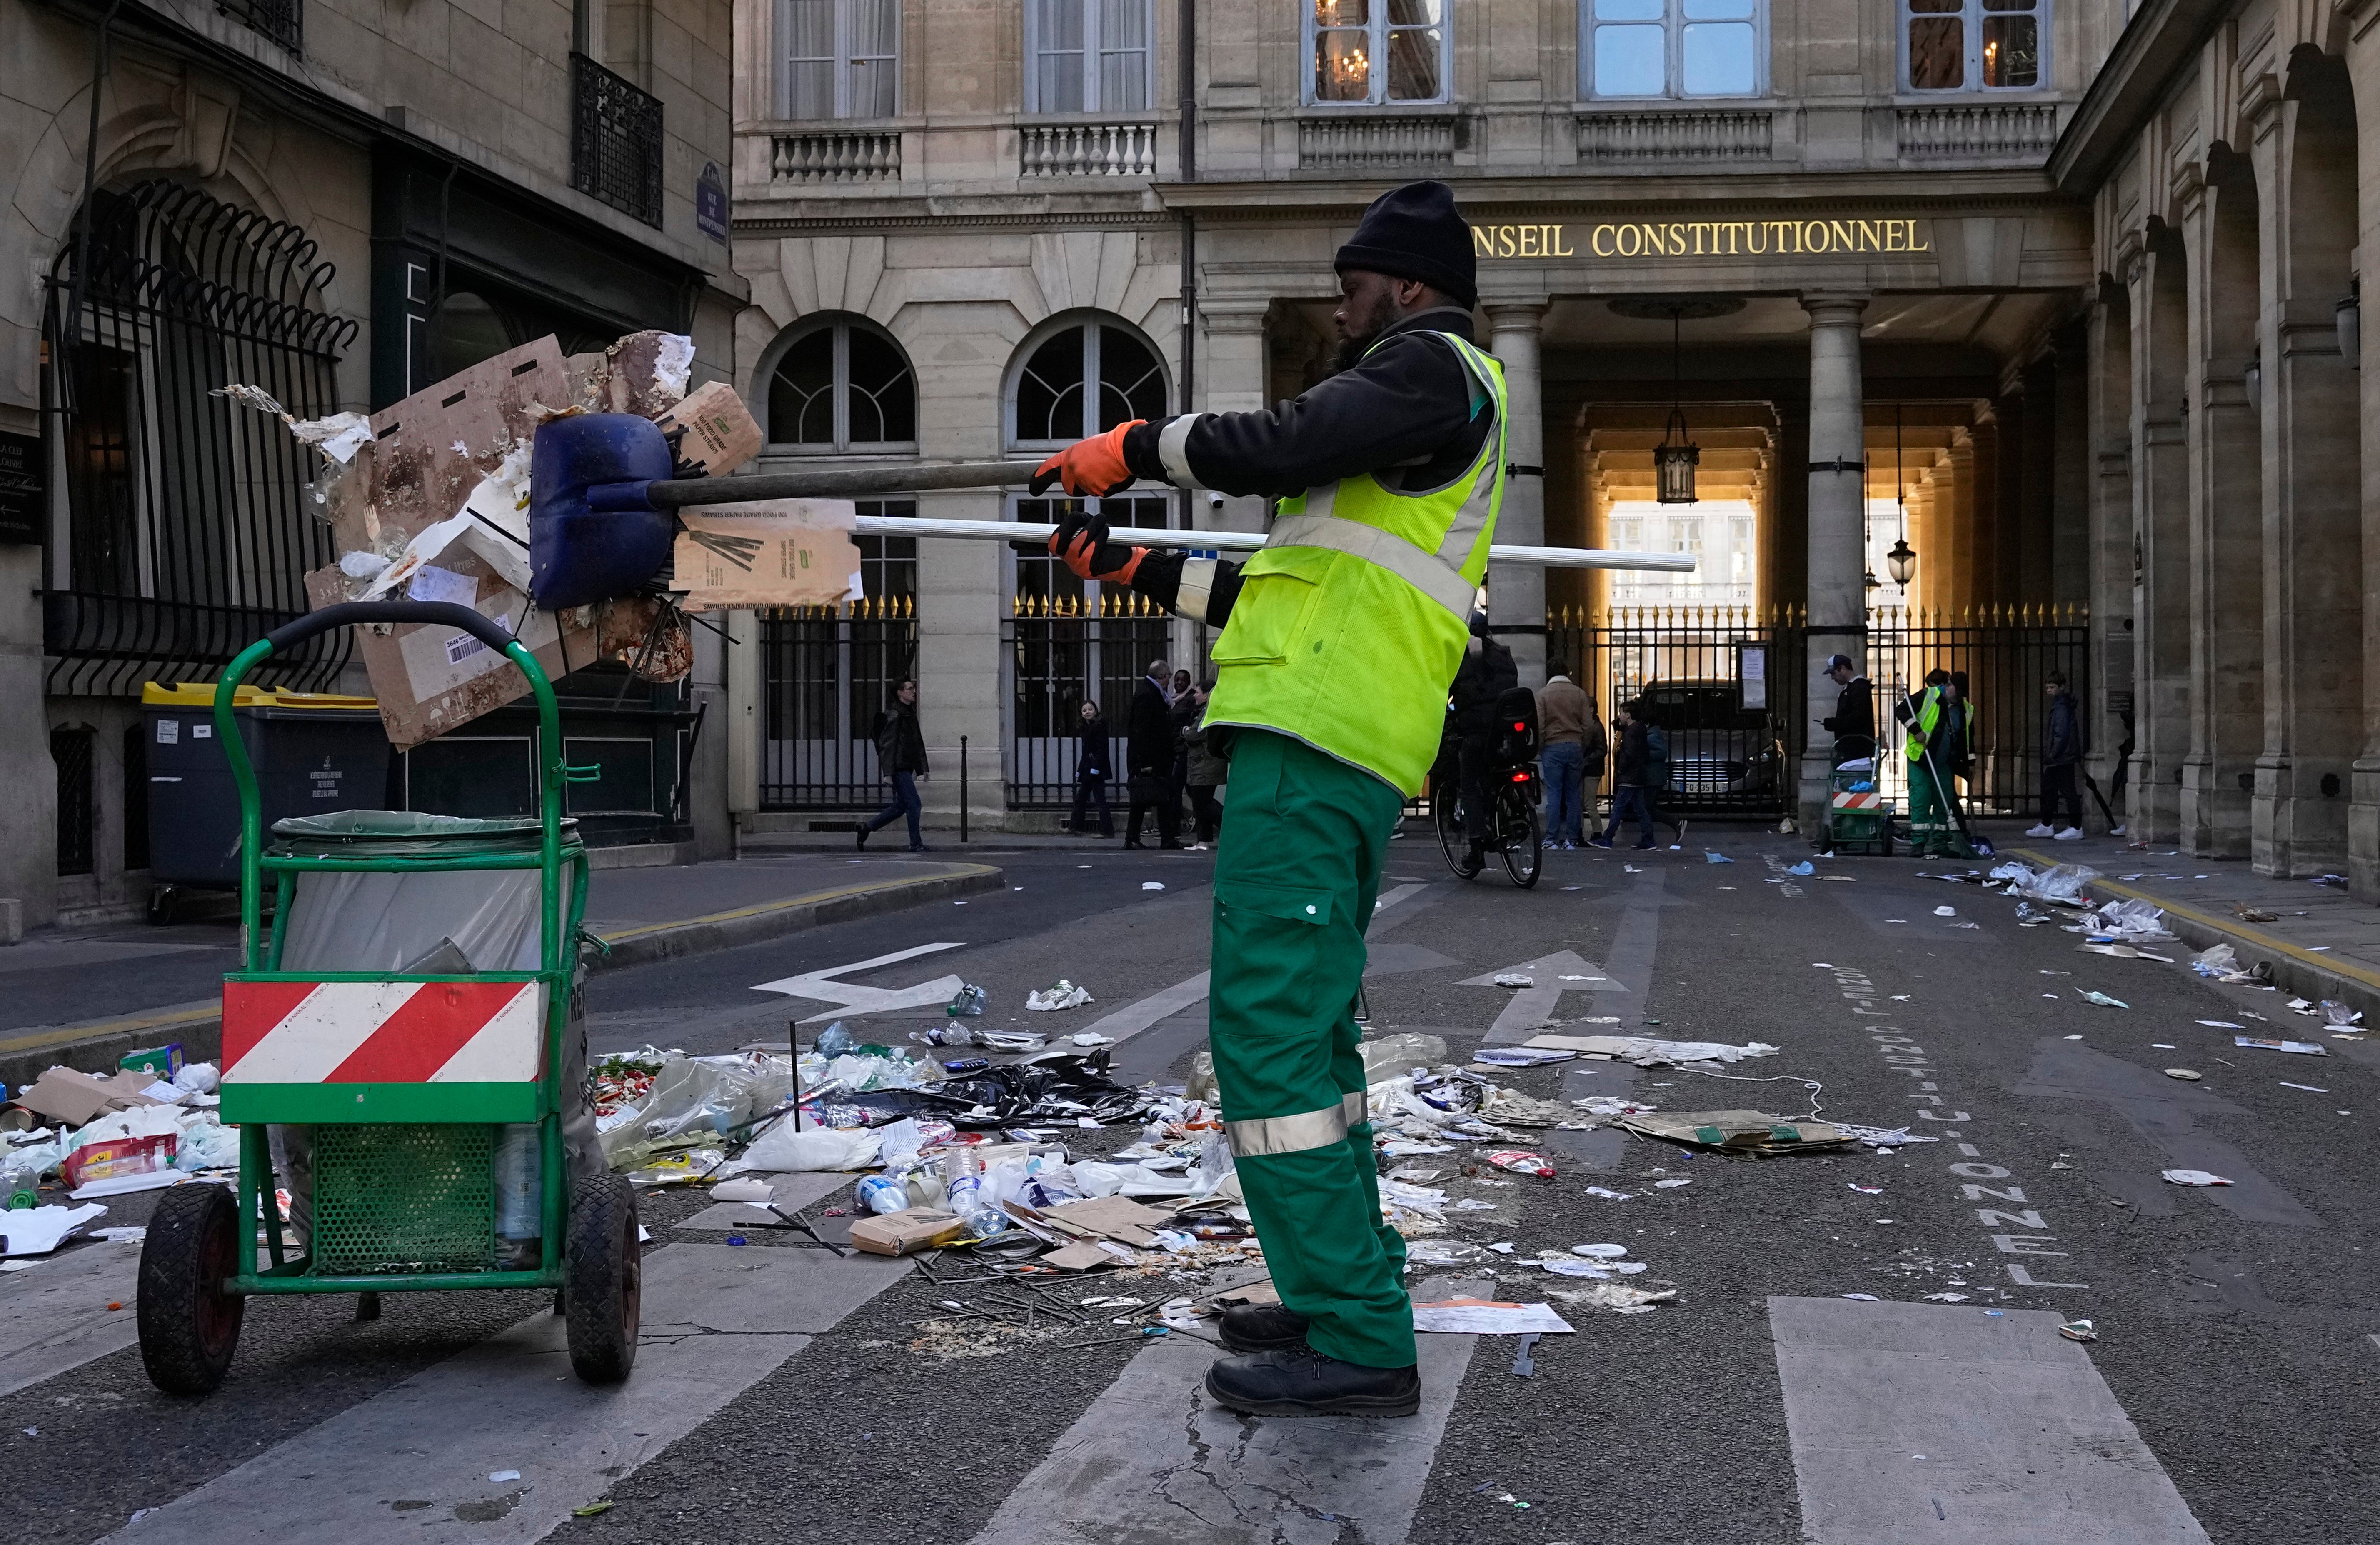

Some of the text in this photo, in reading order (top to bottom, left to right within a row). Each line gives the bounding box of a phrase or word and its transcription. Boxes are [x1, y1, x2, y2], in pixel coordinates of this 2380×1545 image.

[708, 192, 717, 205] RUE
[1473, 220, 1929, 257] NSEIL CONSTITUTIONNEL
[692, 421, 719, 454] PAPER STRAWS
[698, 415, 707, 424] 100
[704, 422, 715, 436] FOOD
[713, 435, 727, 450] GRADE
[447, 638, 459, 648] 3646
[292, 998, 313, 1019] NIKKALITE
[500, 998, 521, 1019] NIKKALITE
